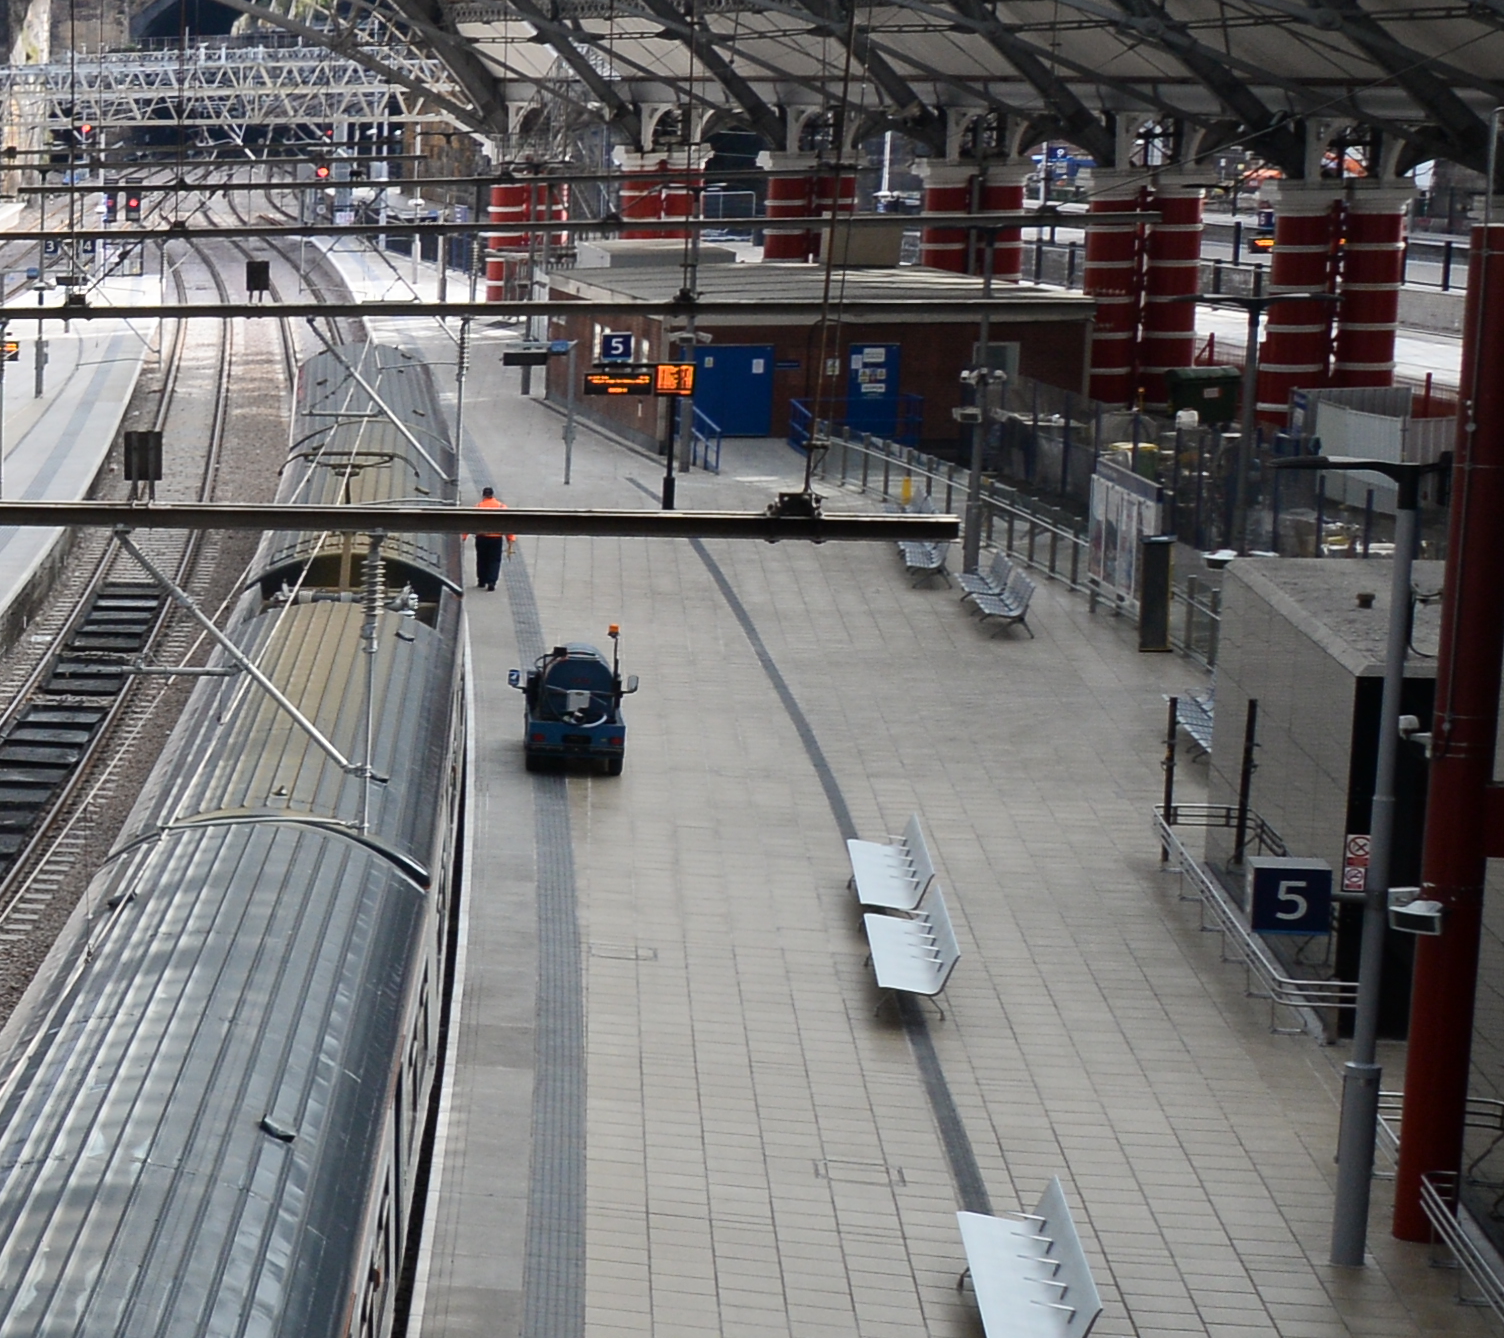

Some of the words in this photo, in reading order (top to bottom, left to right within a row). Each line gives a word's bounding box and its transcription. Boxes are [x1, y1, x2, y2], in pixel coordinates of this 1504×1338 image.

[46, 240, 55, 251] 3
[83, 240, 92, 251] 4
[610, 337, 624, 354] 5
[1275, 880, 1308, 920] 5
